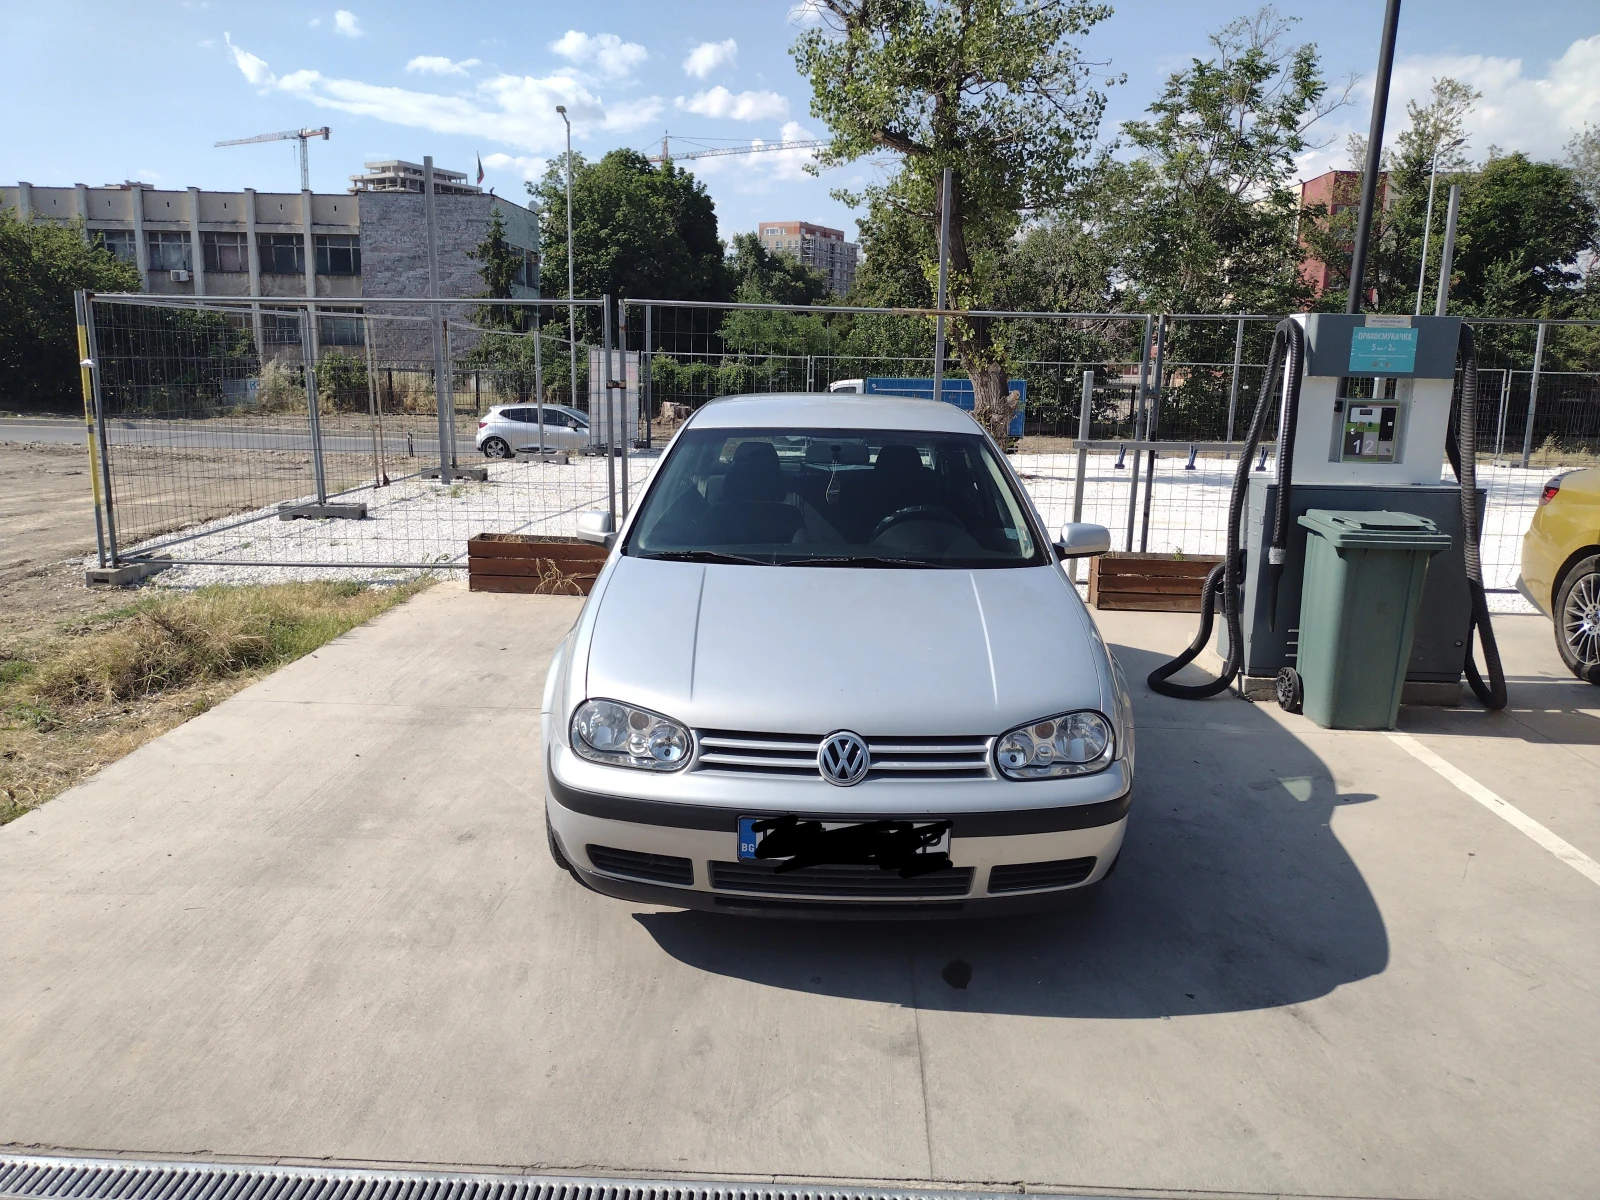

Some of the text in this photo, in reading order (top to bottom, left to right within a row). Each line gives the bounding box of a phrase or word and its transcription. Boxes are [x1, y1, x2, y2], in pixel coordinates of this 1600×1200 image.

[1353, 439, 1374, 454] 1 2
[741, 842, 755, 853] BG
